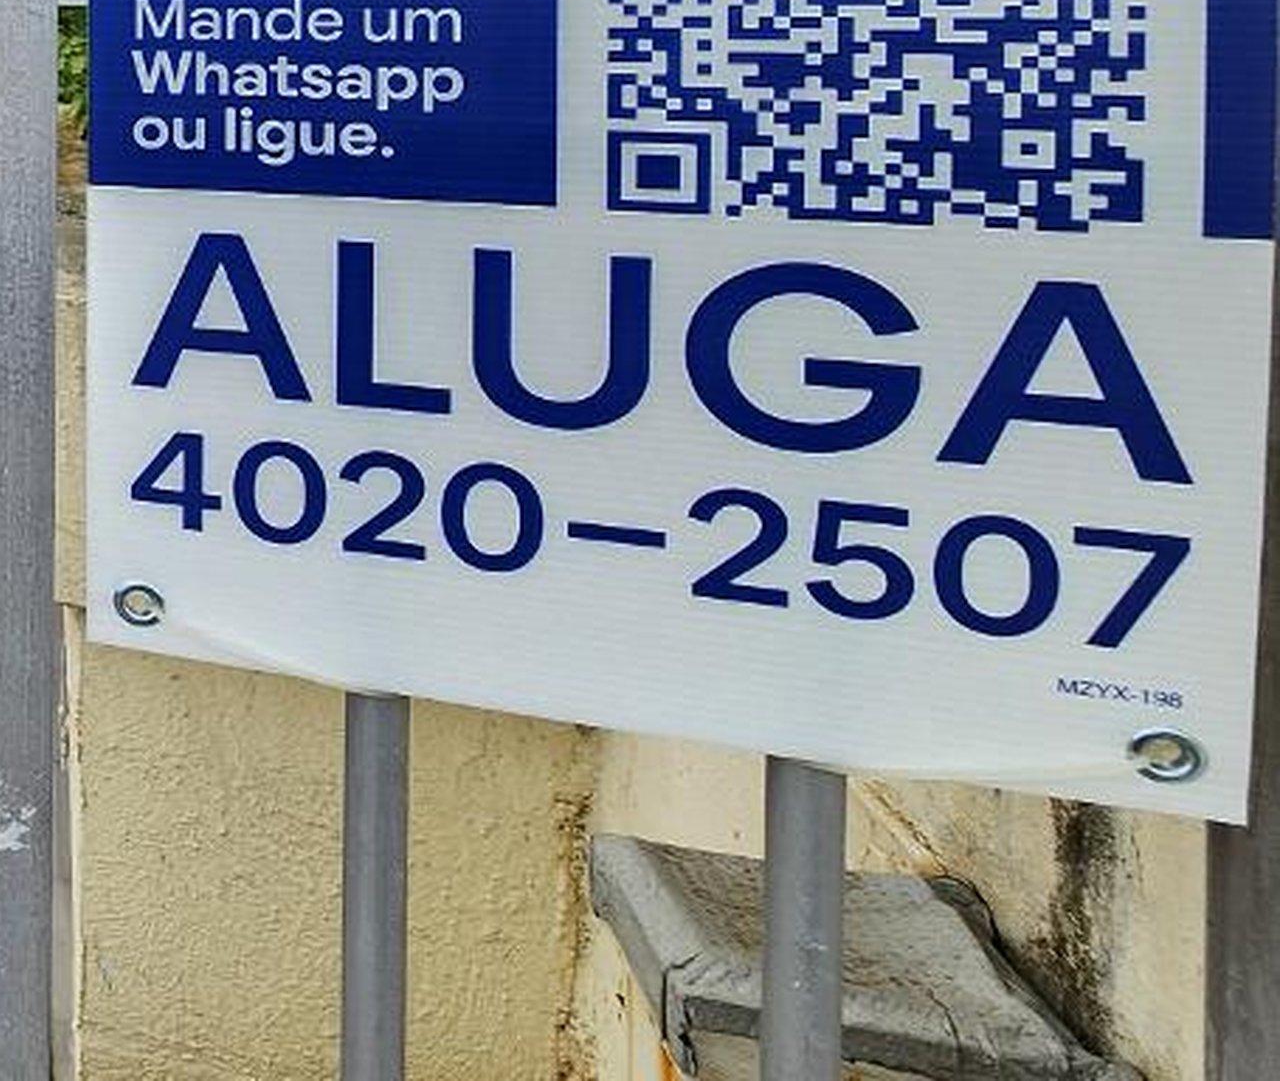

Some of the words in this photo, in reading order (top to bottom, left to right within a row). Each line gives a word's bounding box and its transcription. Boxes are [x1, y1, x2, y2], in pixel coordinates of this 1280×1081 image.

[362, 7, 463, 43] um
[131, 49, 465, 113] Whatsapp
[132, 115, 207, 151] ou
[224, 105, 395, 167] ligue.
[130, 232, 1194, 485] ALUGA
[130, 432, 1192, 648] 4020-2507
